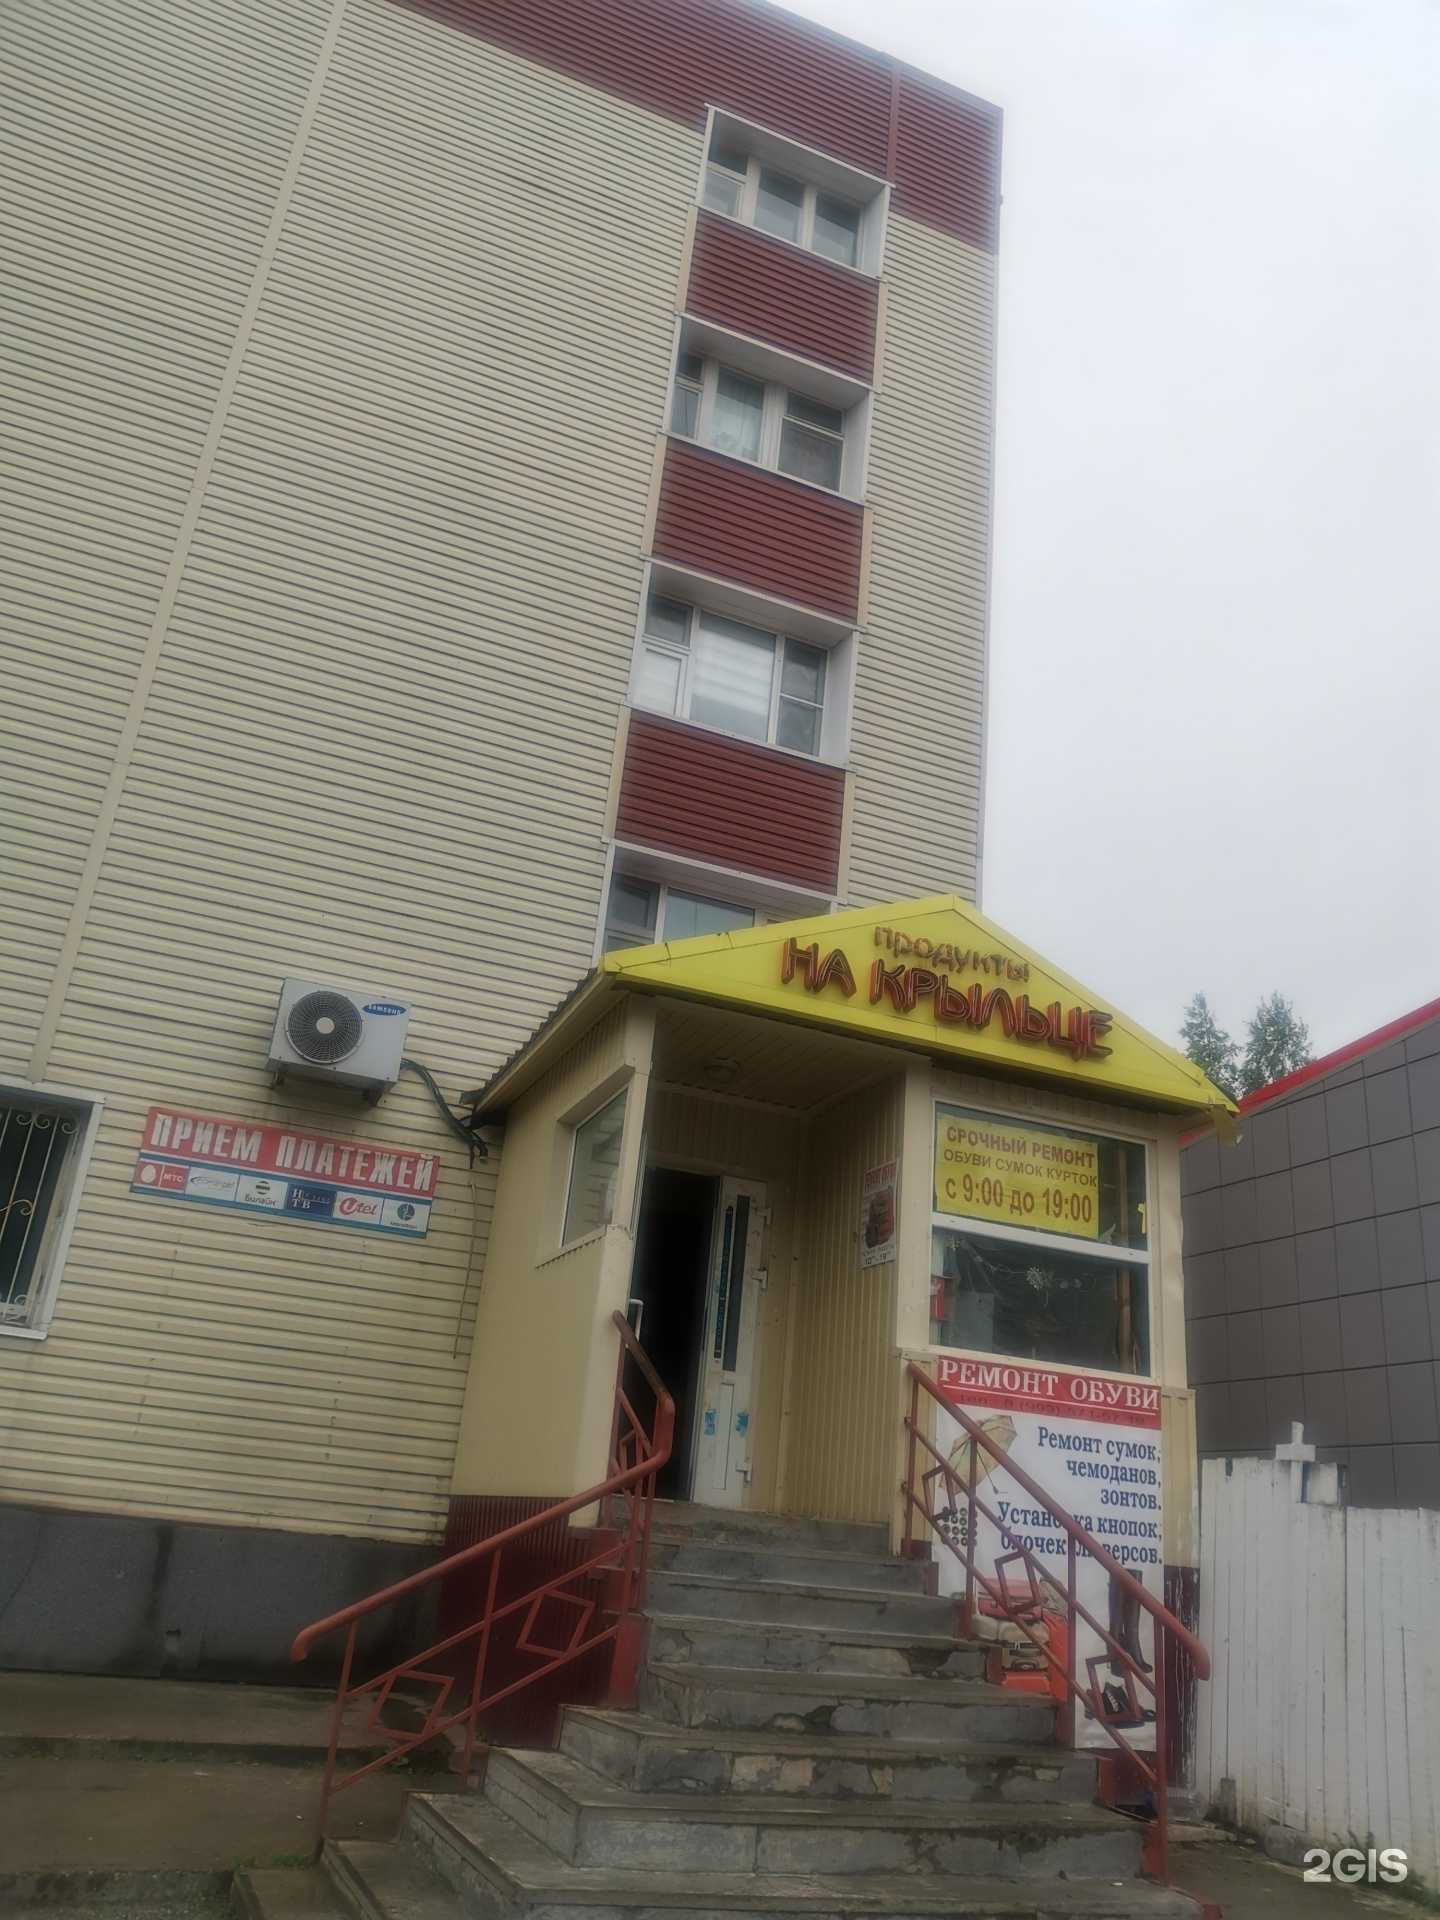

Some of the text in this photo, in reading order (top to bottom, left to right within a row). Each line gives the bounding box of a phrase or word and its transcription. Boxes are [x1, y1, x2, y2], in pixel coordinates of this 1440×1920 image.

[781, 937, 1114, 1062] НА КРЫЛЬЦЕ
[151, 1113, 436, 1192] ПРИЕМ ПЛАТЕЖЕЙ
[946, 1126, 1095, 1168] СРОЧНЫЙ РЕМОНТ
[943, 1149, 1097, 1187] ОБУВИ СУМОК КУРТОК
[962, 1173, 1004, 1207] 9:00
[1042, 1187, 1092, 1223] 19:00
[939, 1359, 1161, 1410] РЕМОНТ ОБУВИ
[1038, 1426, 1102, 1454] Ремонт
[1066, 1459, 1161, 1488] чемоданов,
[1100, 1487, 1162, 1510] зонтов.
[1096, 1517, 1161, 1541] кнопок,
